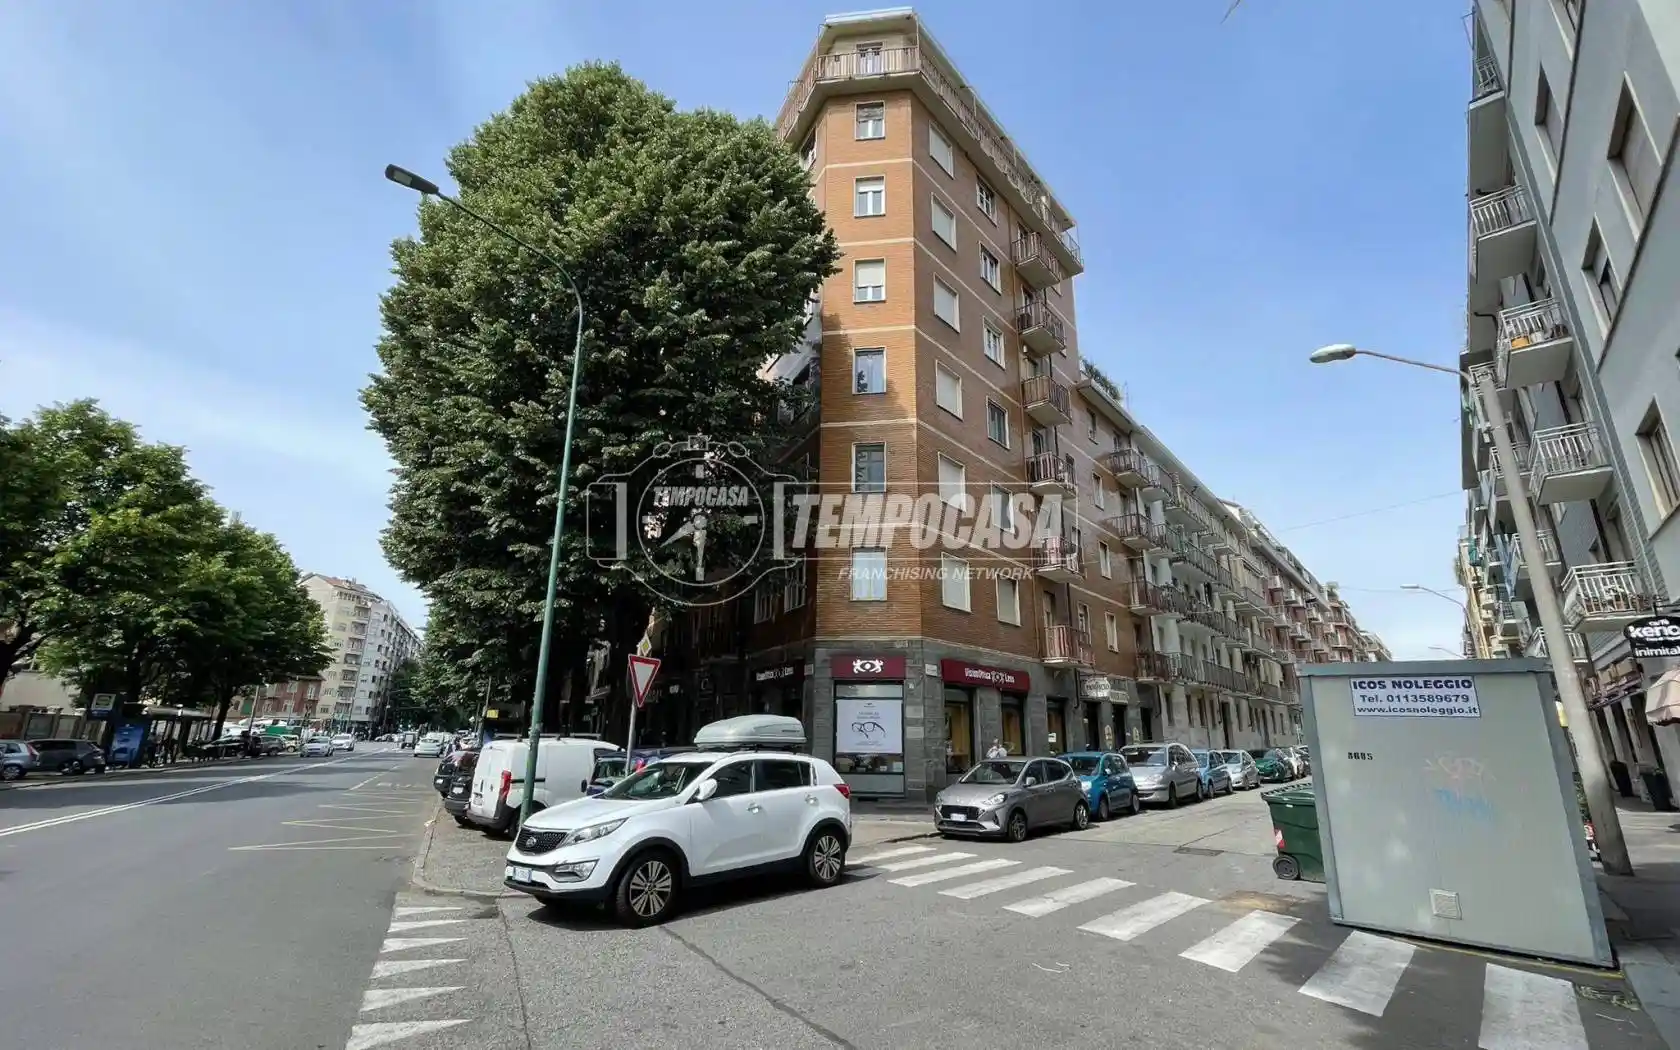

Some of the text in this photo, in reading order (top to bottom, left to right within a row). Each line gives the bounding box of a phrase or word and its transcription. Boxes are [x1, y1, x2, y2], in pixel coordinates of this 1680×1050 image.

[1352, 679, 1473, 690] ICOS NOLEGGIO
[1360, 694, 1469, 703] Tel. 0113589679
[1357, 705, 1478, 716] www.icosnoleggio.it
